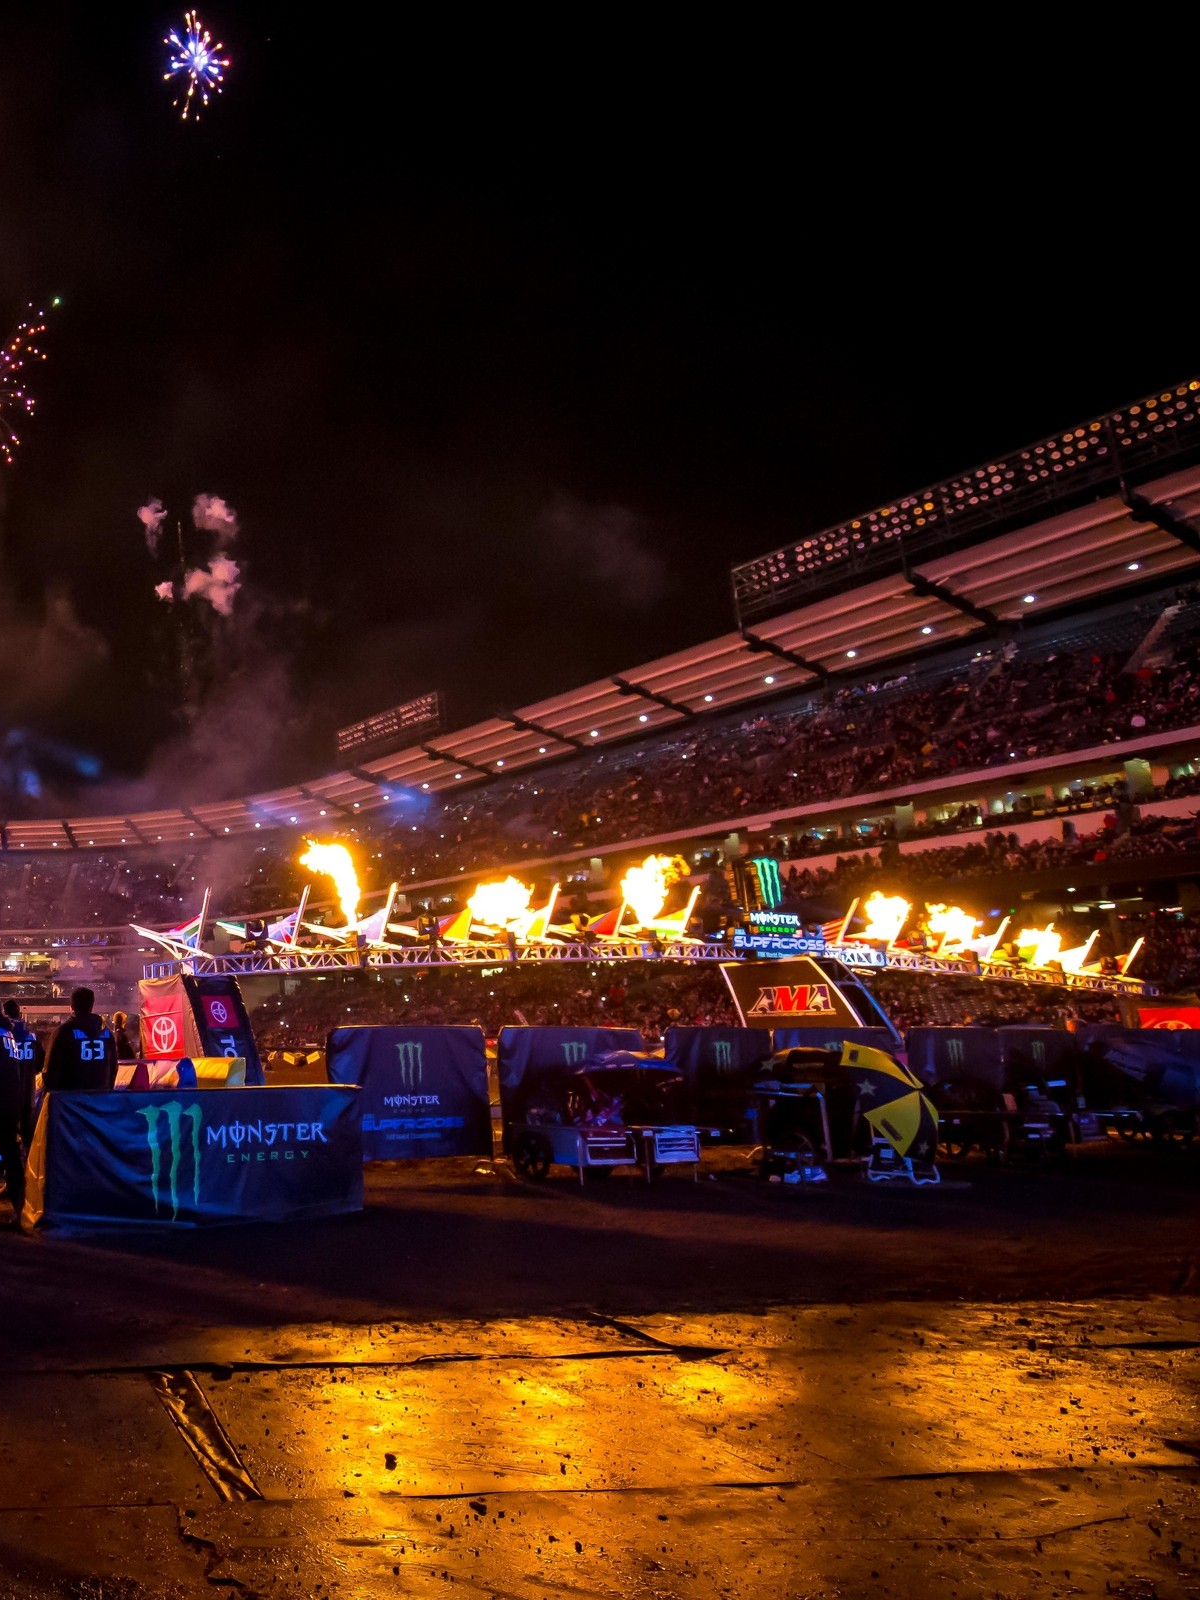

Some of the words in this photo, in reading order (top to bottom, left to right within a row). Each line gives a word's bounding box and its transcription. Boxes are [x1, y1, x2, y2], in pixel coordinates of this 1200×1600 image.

[749, 911, 801, 926] MONSTER
[759, 925, 796, 934] ENERGY
[733, 935, 825, 951] SUPERCROSS
[747, 983, 836, 1014] AMA
[80, 1040, 105, 1060] 63
[383, 1094, 440, 1107] MONSTER
[206, 1119, 328, 1149] MONSTER
[227, 1150, 310, 1163] ENERGY
